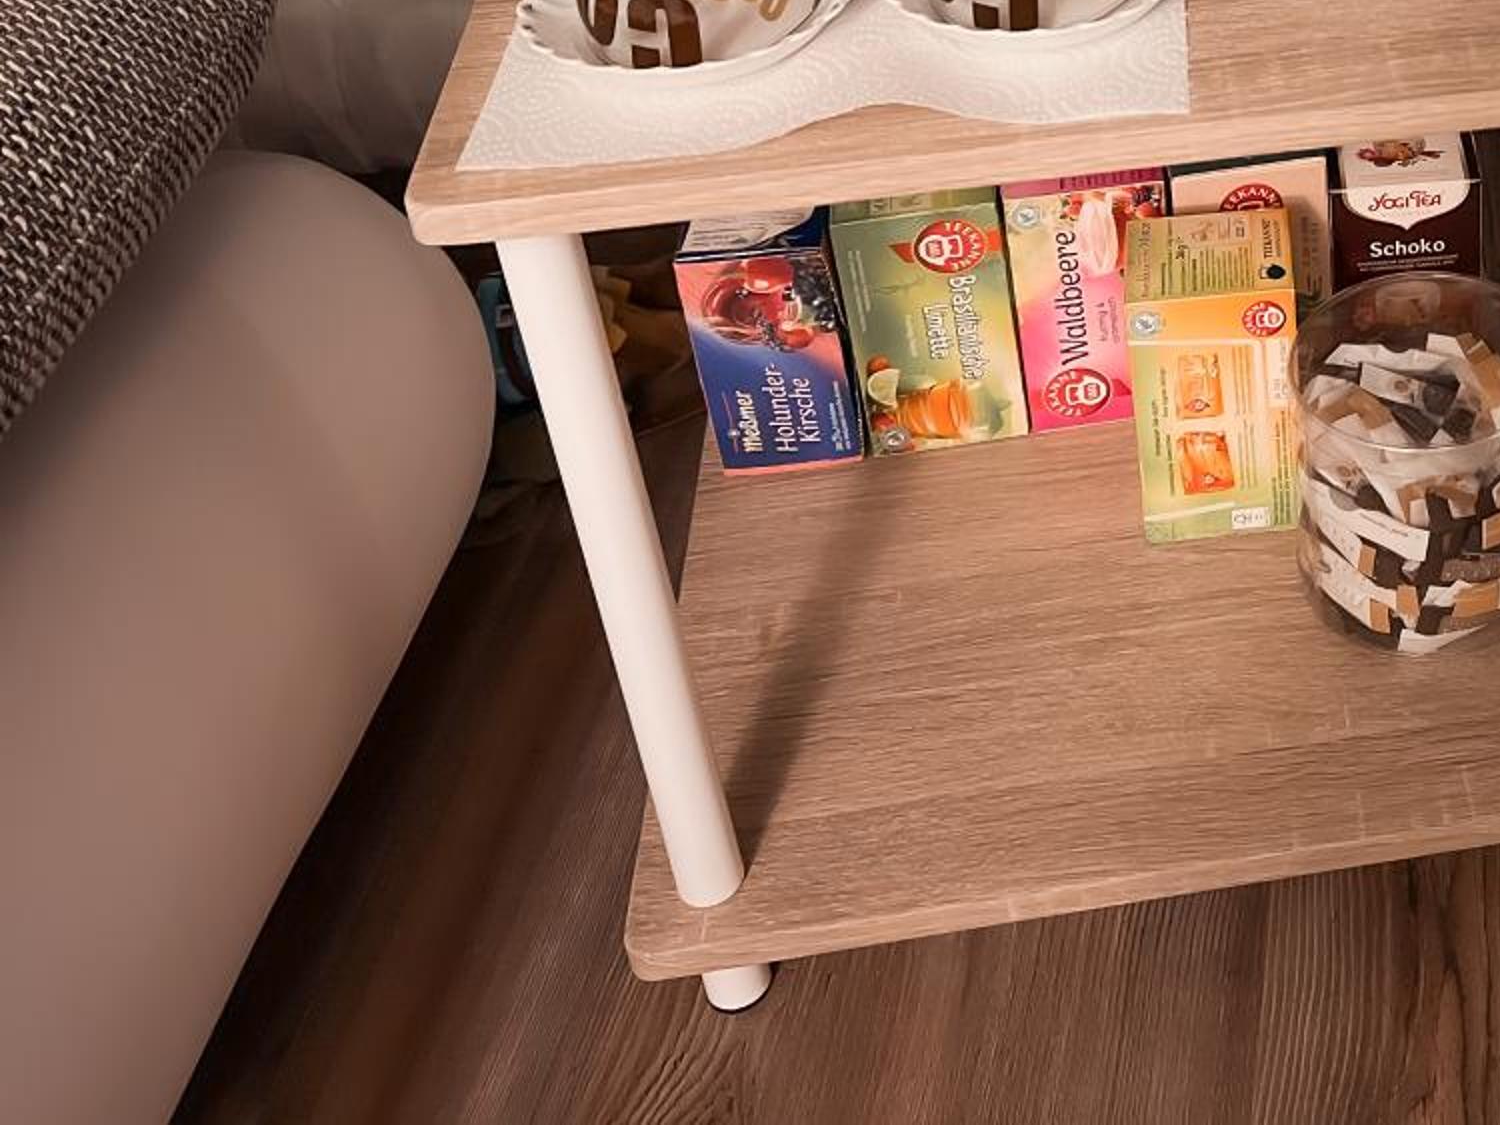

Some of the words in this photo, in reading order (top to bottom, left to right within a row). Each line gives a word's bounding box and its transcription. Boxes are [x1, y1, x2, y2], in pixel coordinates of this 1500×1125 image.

[1369, 237, 1446, 258] Schoko
[923, 303, 951, 360] Limette
[948, 276, 985, 378] Brasilianische
[1055, 231, 1089, 366] Waldbeere
[762, 363, 799, 452] Holunder-
[789, 378, 822, 443] Kirsche
